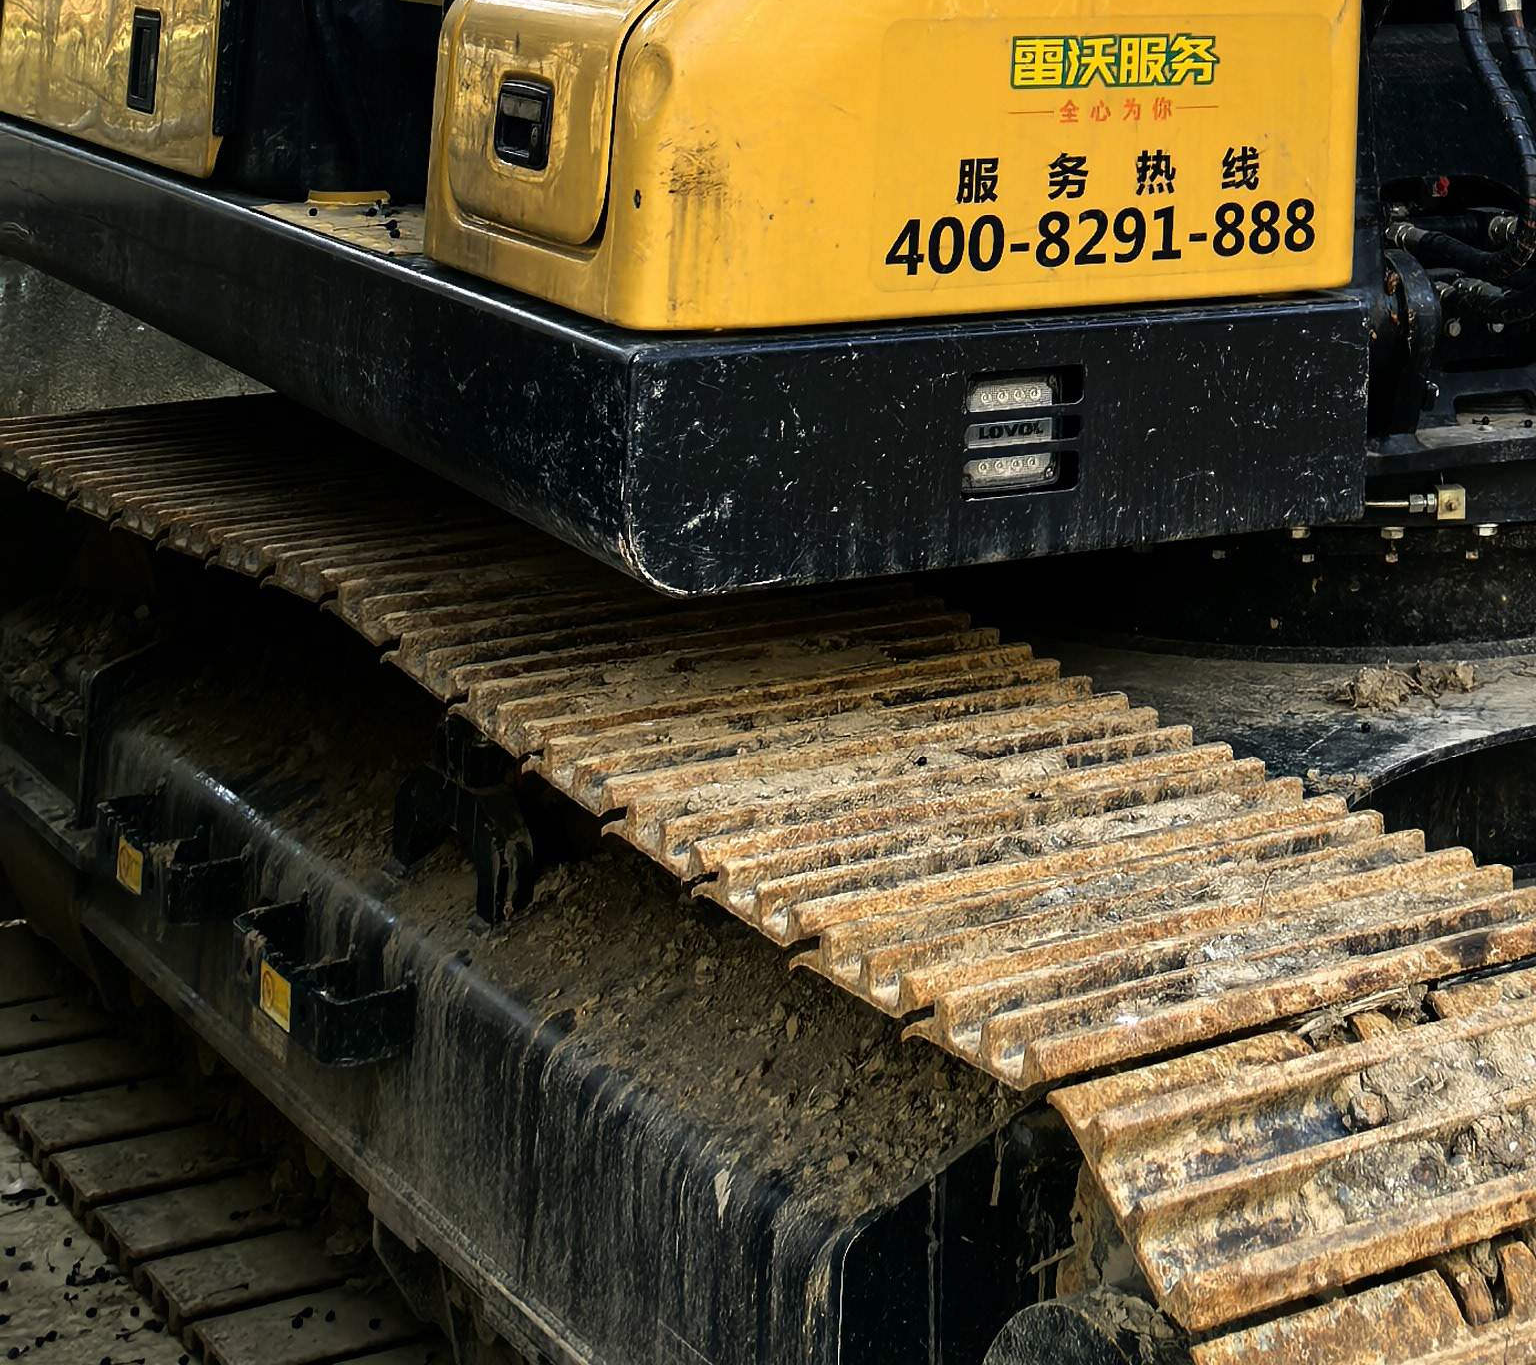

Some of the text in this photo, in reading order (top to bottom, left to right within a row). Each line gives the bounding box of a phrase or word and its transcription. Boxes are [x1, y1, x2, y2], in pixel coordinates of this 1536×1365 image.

[1011, 33, 1220, 89] 雷沃服务
[1059, 96, 1174, 124] 全心为你
[956, 146, 1260, 204] 服务热线
[885, 198, 1316, 276] 400-8291-888
[978, 423, 1044, 440] LOVOL
